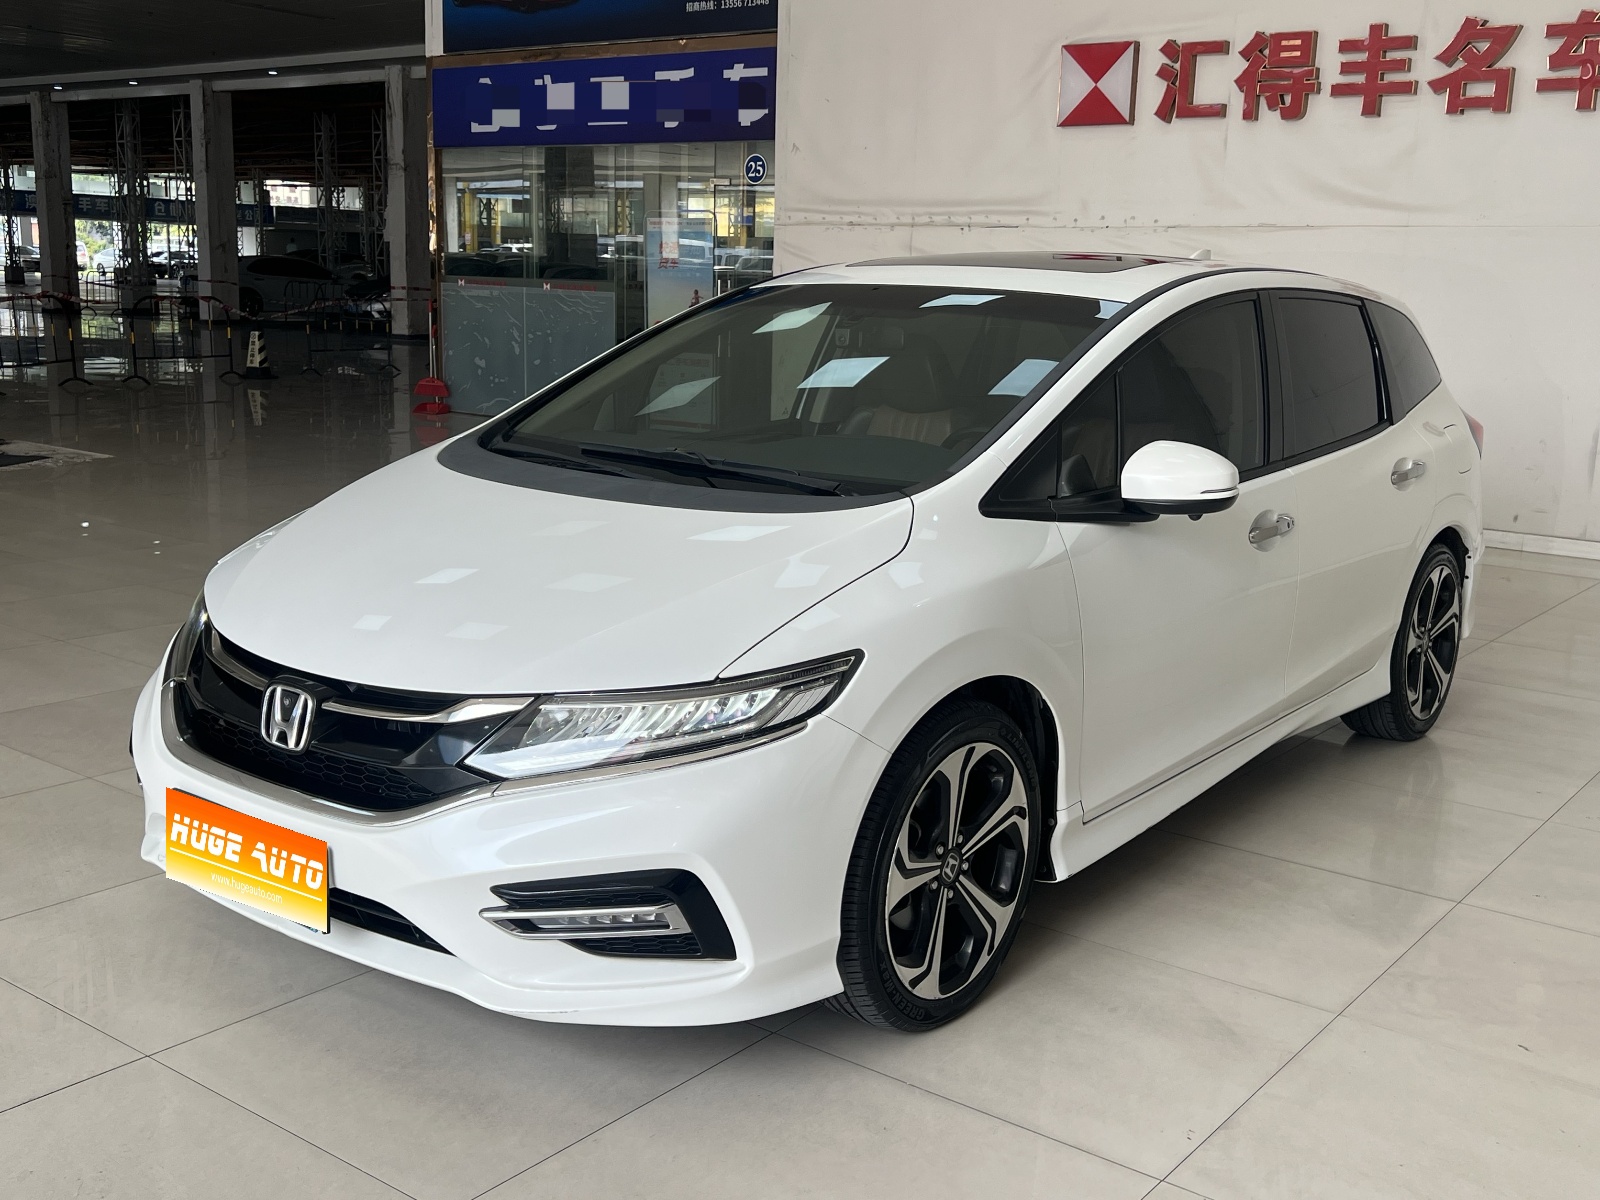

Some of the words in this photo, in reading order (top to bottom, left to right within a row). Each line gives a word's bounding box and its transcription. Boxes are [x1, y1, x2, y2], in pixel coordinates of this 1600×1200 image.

[1154, 8, 1600, 124] 汇得丰名车
[748, 161, 763, 177] 25
